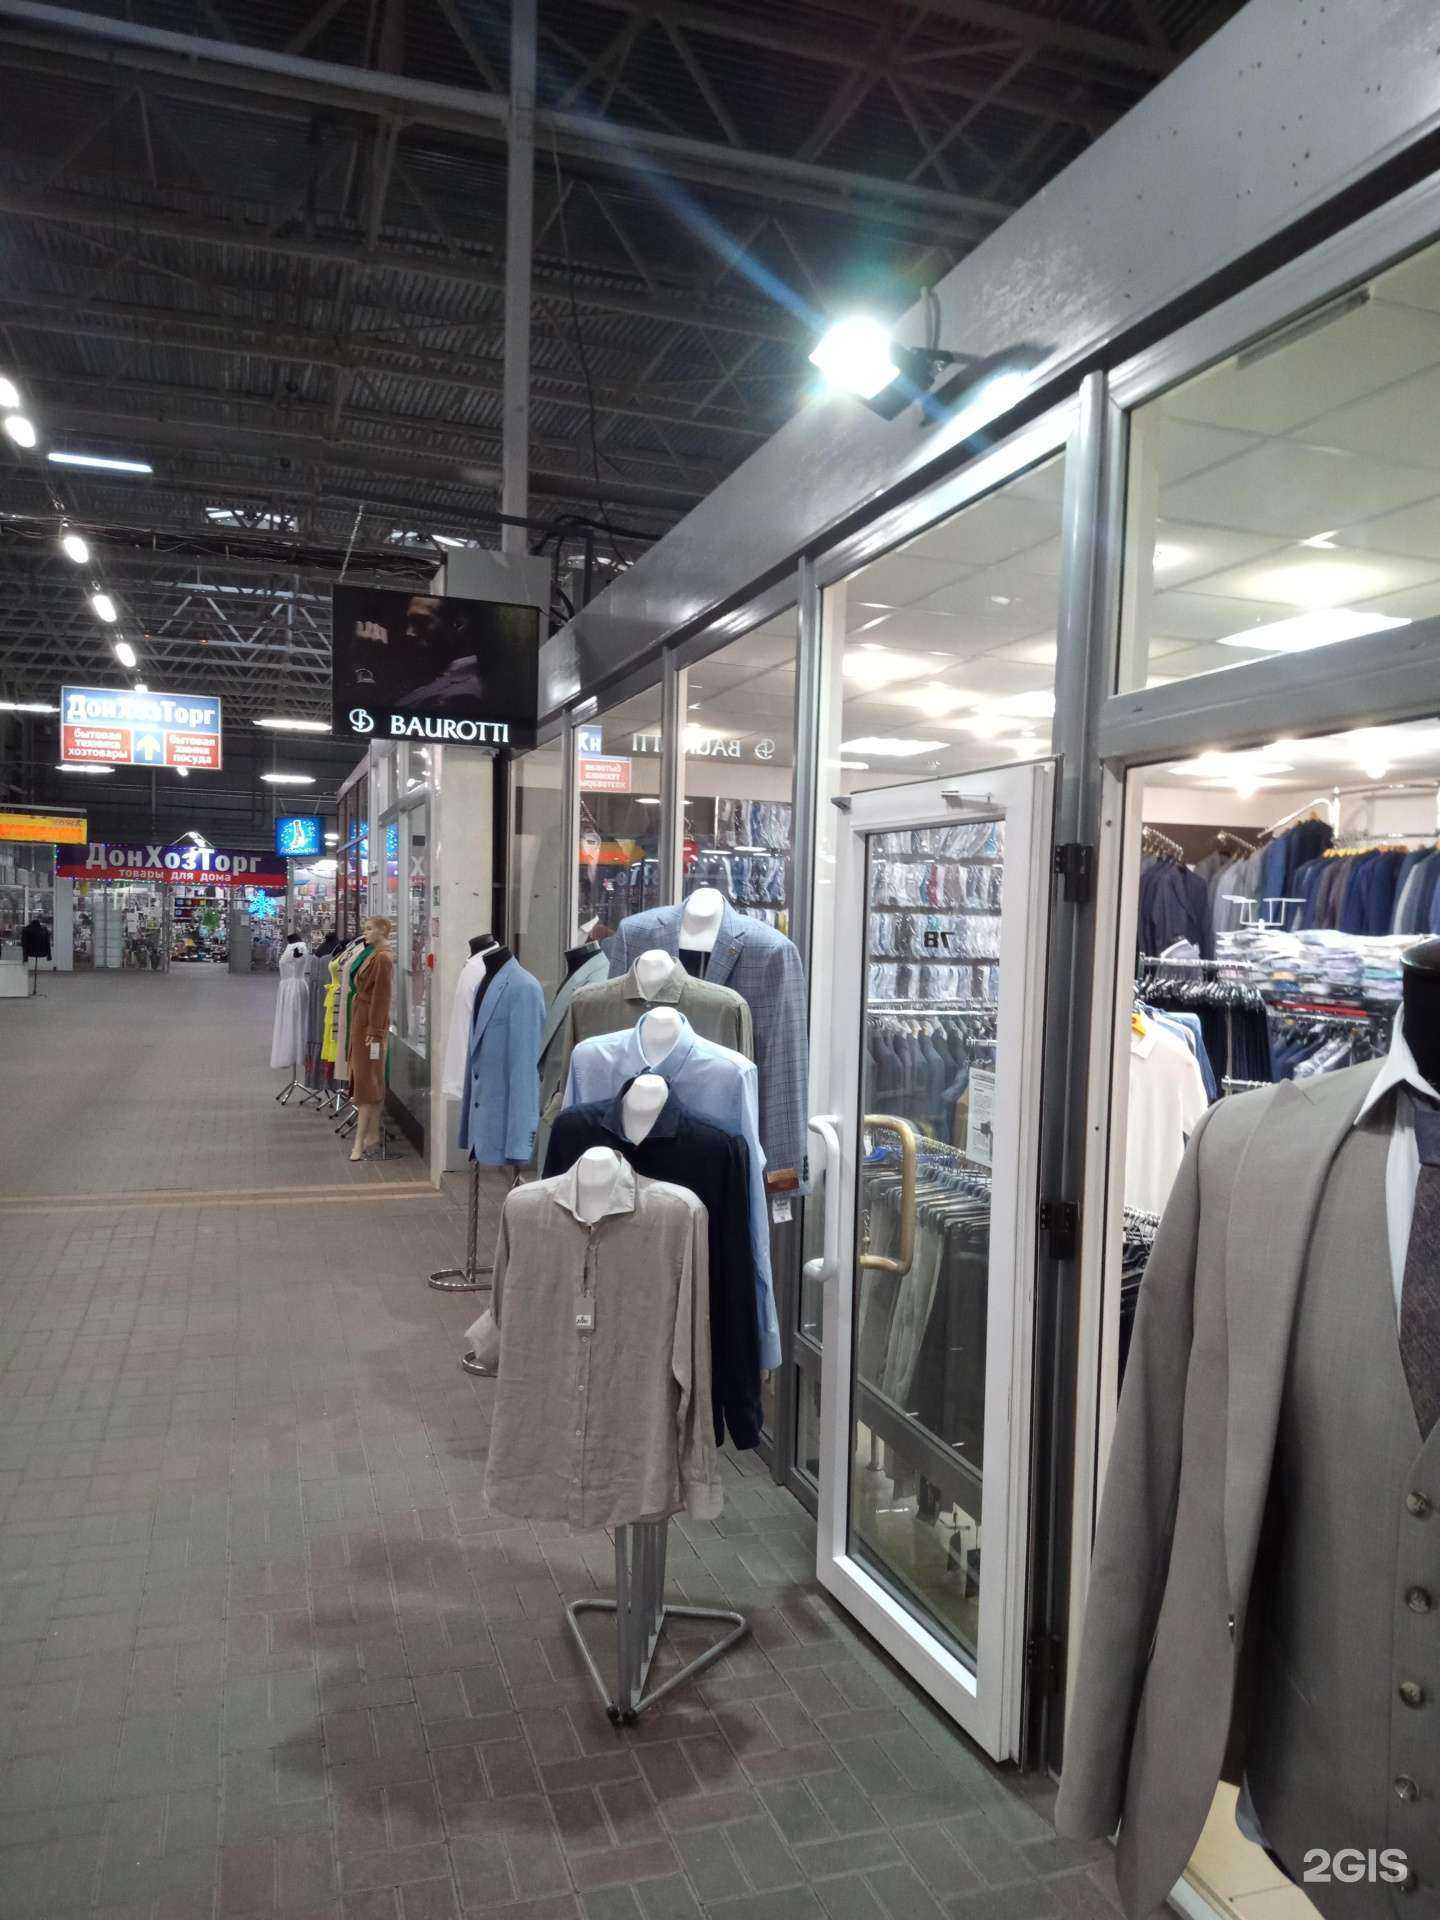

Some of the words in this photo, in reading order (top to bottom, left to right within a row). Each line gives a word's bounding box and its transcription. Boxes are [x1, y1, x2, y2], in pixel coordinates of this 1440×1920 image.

[390, 714, 510, 743] BAUROTTI
[67, 747, 128, 760] хозтовары
[86, 842, 264, 876] ДонХозТорг
[119, 868, 164, 880] товары
[171, 871, 194, 881] для
[201, 872, 231, 882] дома
